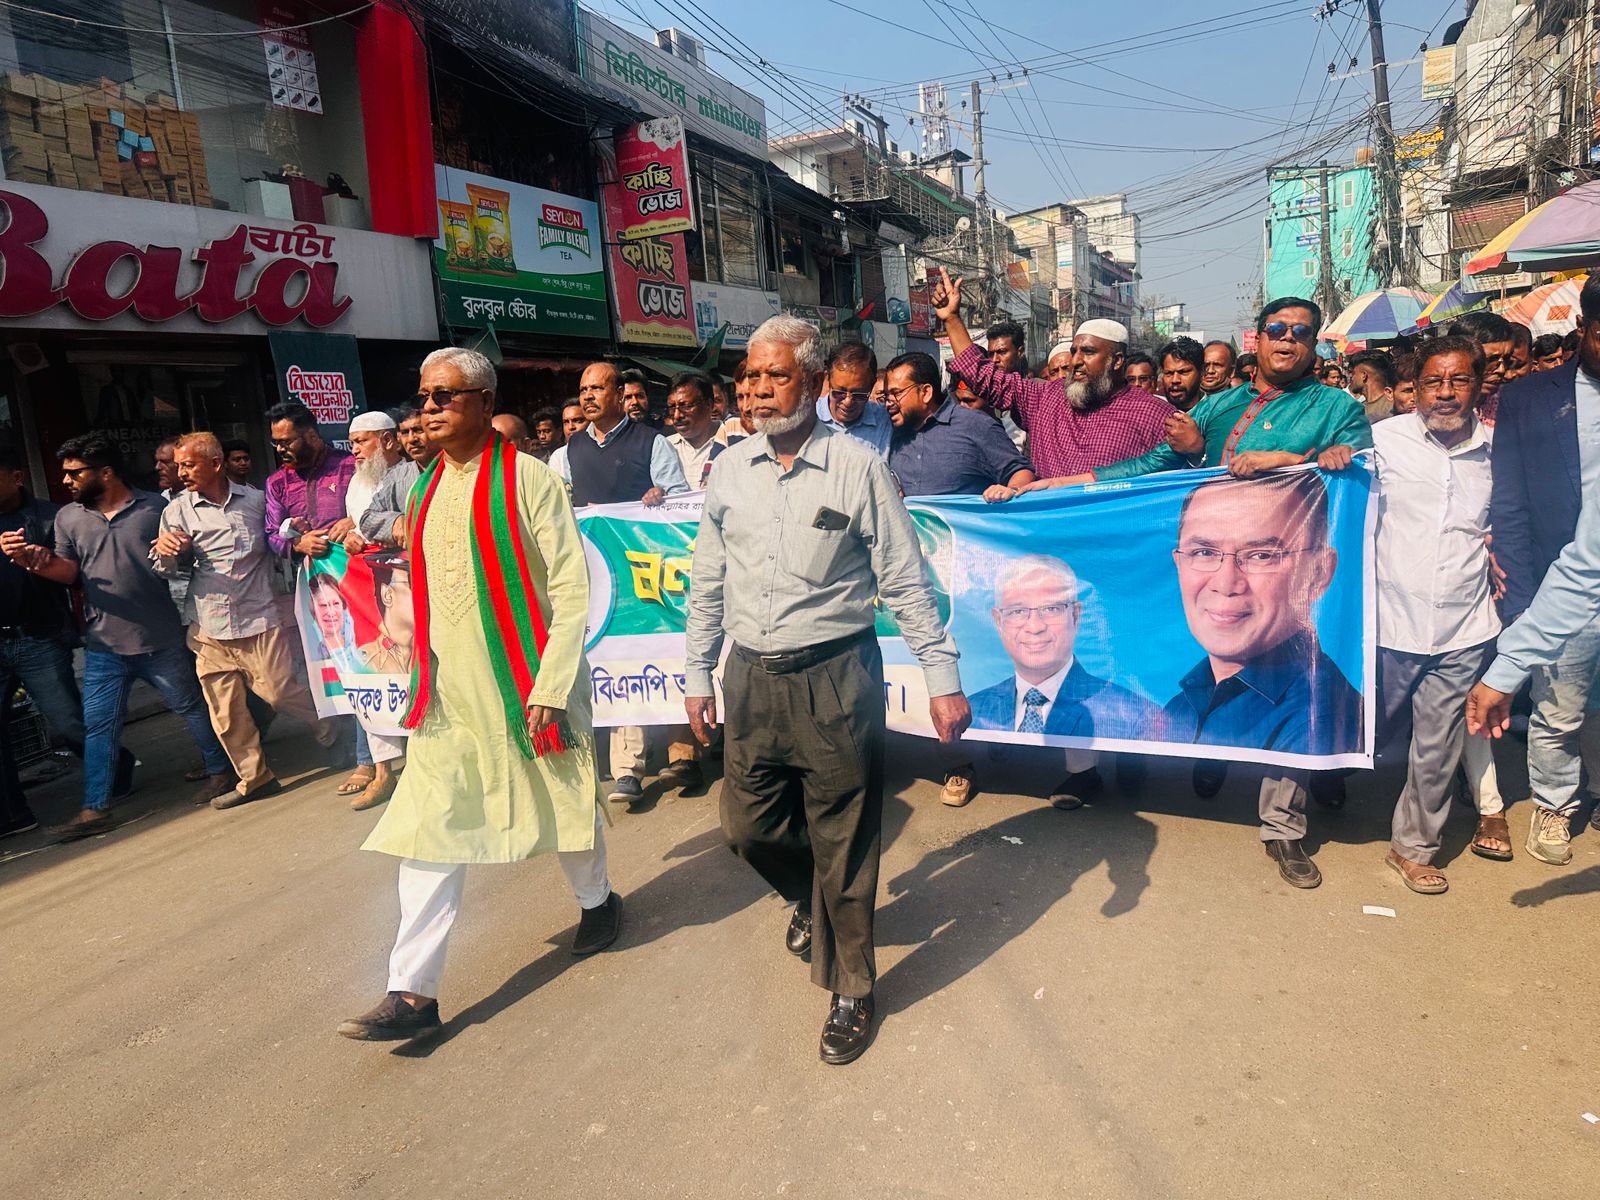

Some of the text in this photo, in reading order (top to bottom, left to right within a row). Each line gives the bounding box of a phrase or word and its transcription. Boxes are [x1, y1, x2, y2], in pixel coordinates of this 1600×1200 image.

[603, 39, 687, 110] মিনিস্টার
[698, 93, 761, 140] minister
[638, 188, 682, 215] ভোজ
[545, 207, 580, 227] SEYLON
[249, 225, 336, 258] বাটা
[539, 225, 590, 255] FAMILY BLEND
[560, 251, 573, 260] TEA
[461, 296, 504, 321] বুলবুল
[638, 280, 686, 319] ভোজ
[287, 366, 345, 391] বিজয়ের
[311, 407, 348, 422] কসাথে
[591, 664, 668, 705] বিএনপি
